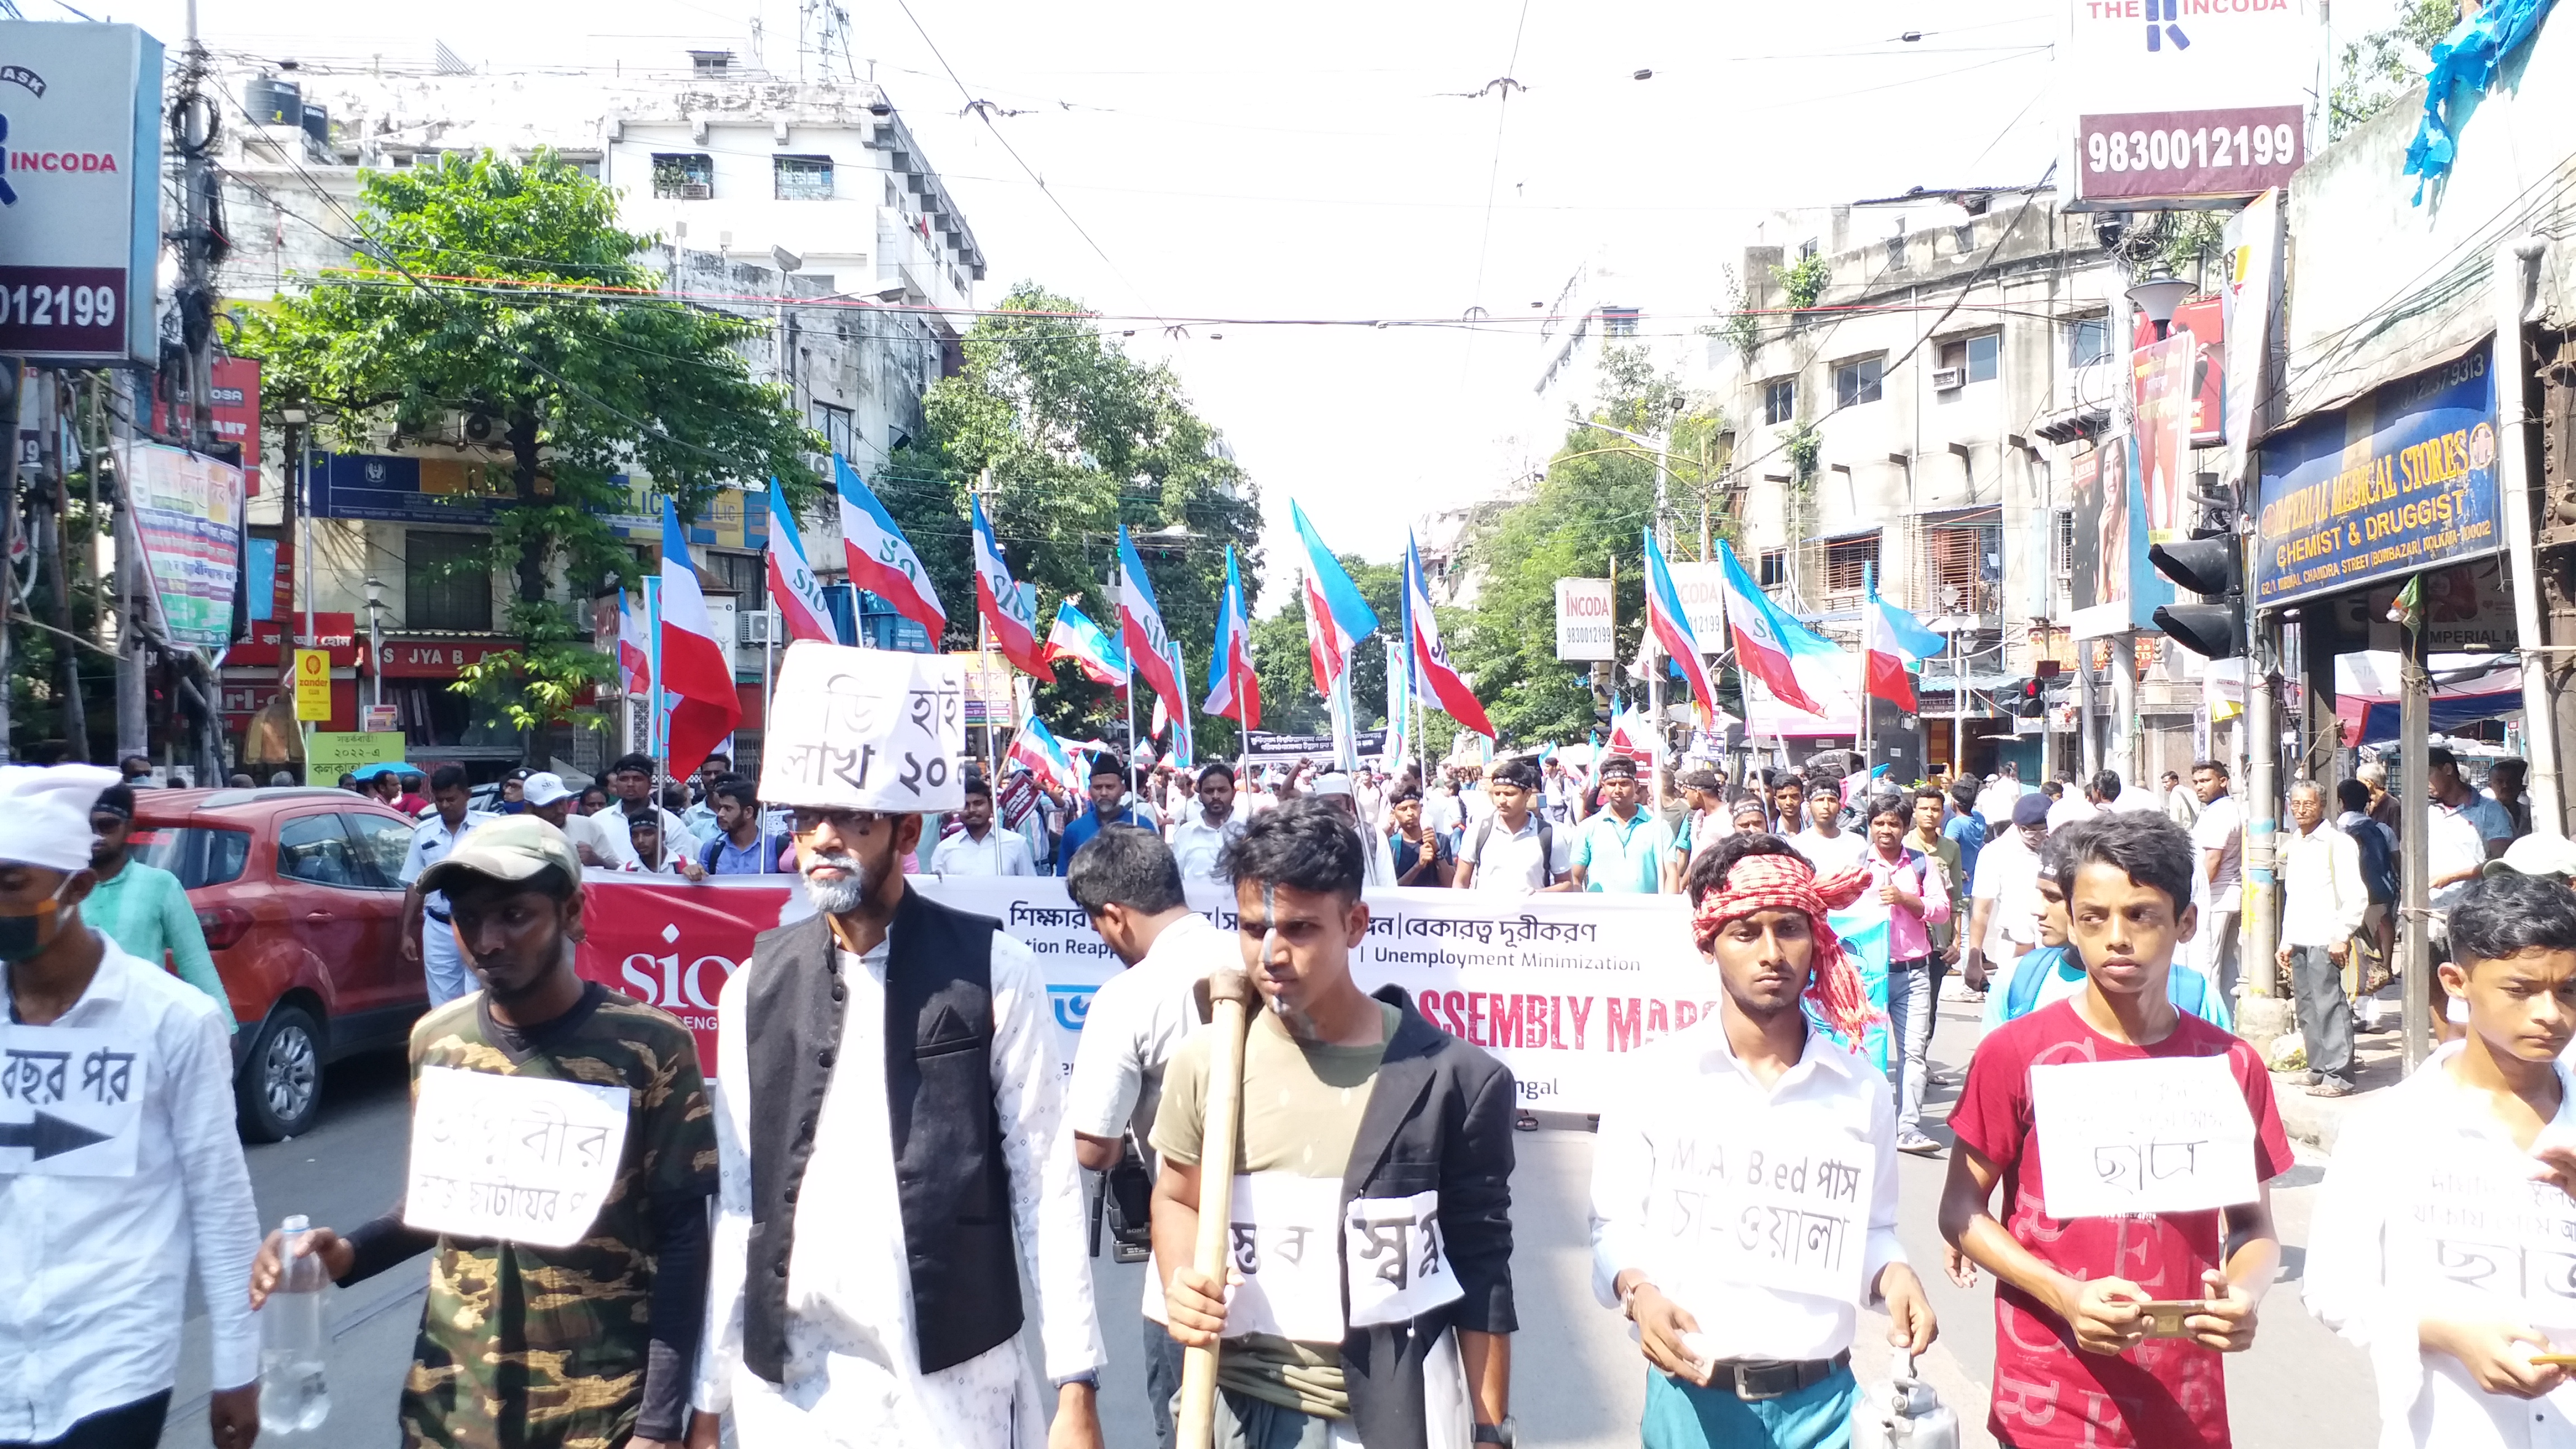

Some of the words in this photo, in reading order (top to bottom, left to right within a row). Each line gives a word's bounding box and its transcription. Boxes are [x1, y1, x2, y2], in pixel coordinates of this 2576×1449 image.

[2087, 1, 2139, 18] THE
[3, 68, 43, 93] ASK
[11, 151, 116, 172] INCODA
[2089, 124, 2294, 173] 9830012199
[2275, 481, 2328, 535] IMPERIAL
[2331, 454, 2397, 517] MEDICAL
[2400, 429, 2470, 493] STORES
[2276, 527, 2341, 567] CHEMIST
[2348, 522, 2361, 546] &
[2365, 490, 2463, 541] DRUGGIST
[2303, 565, 2340, 583] CHANDRA
[2342, 558, 2369, 575] STREET
[1567, 627, 1611, 643] 9830012199
[299, 678, 328, 687] zander
[782, 741, 876, 790] লাখ
[1010, 900, 1086, 929] শিক্ষার
[1405, 917, 1494, 944] বেকারত্ব
[1499, 915, 1597, 948] দূরীকরণ
[1375, 946, 1515, 970] Unemployment
[1521, 951, 1640, 972] Minimization
[82, 1045, 138, 1106] পর
